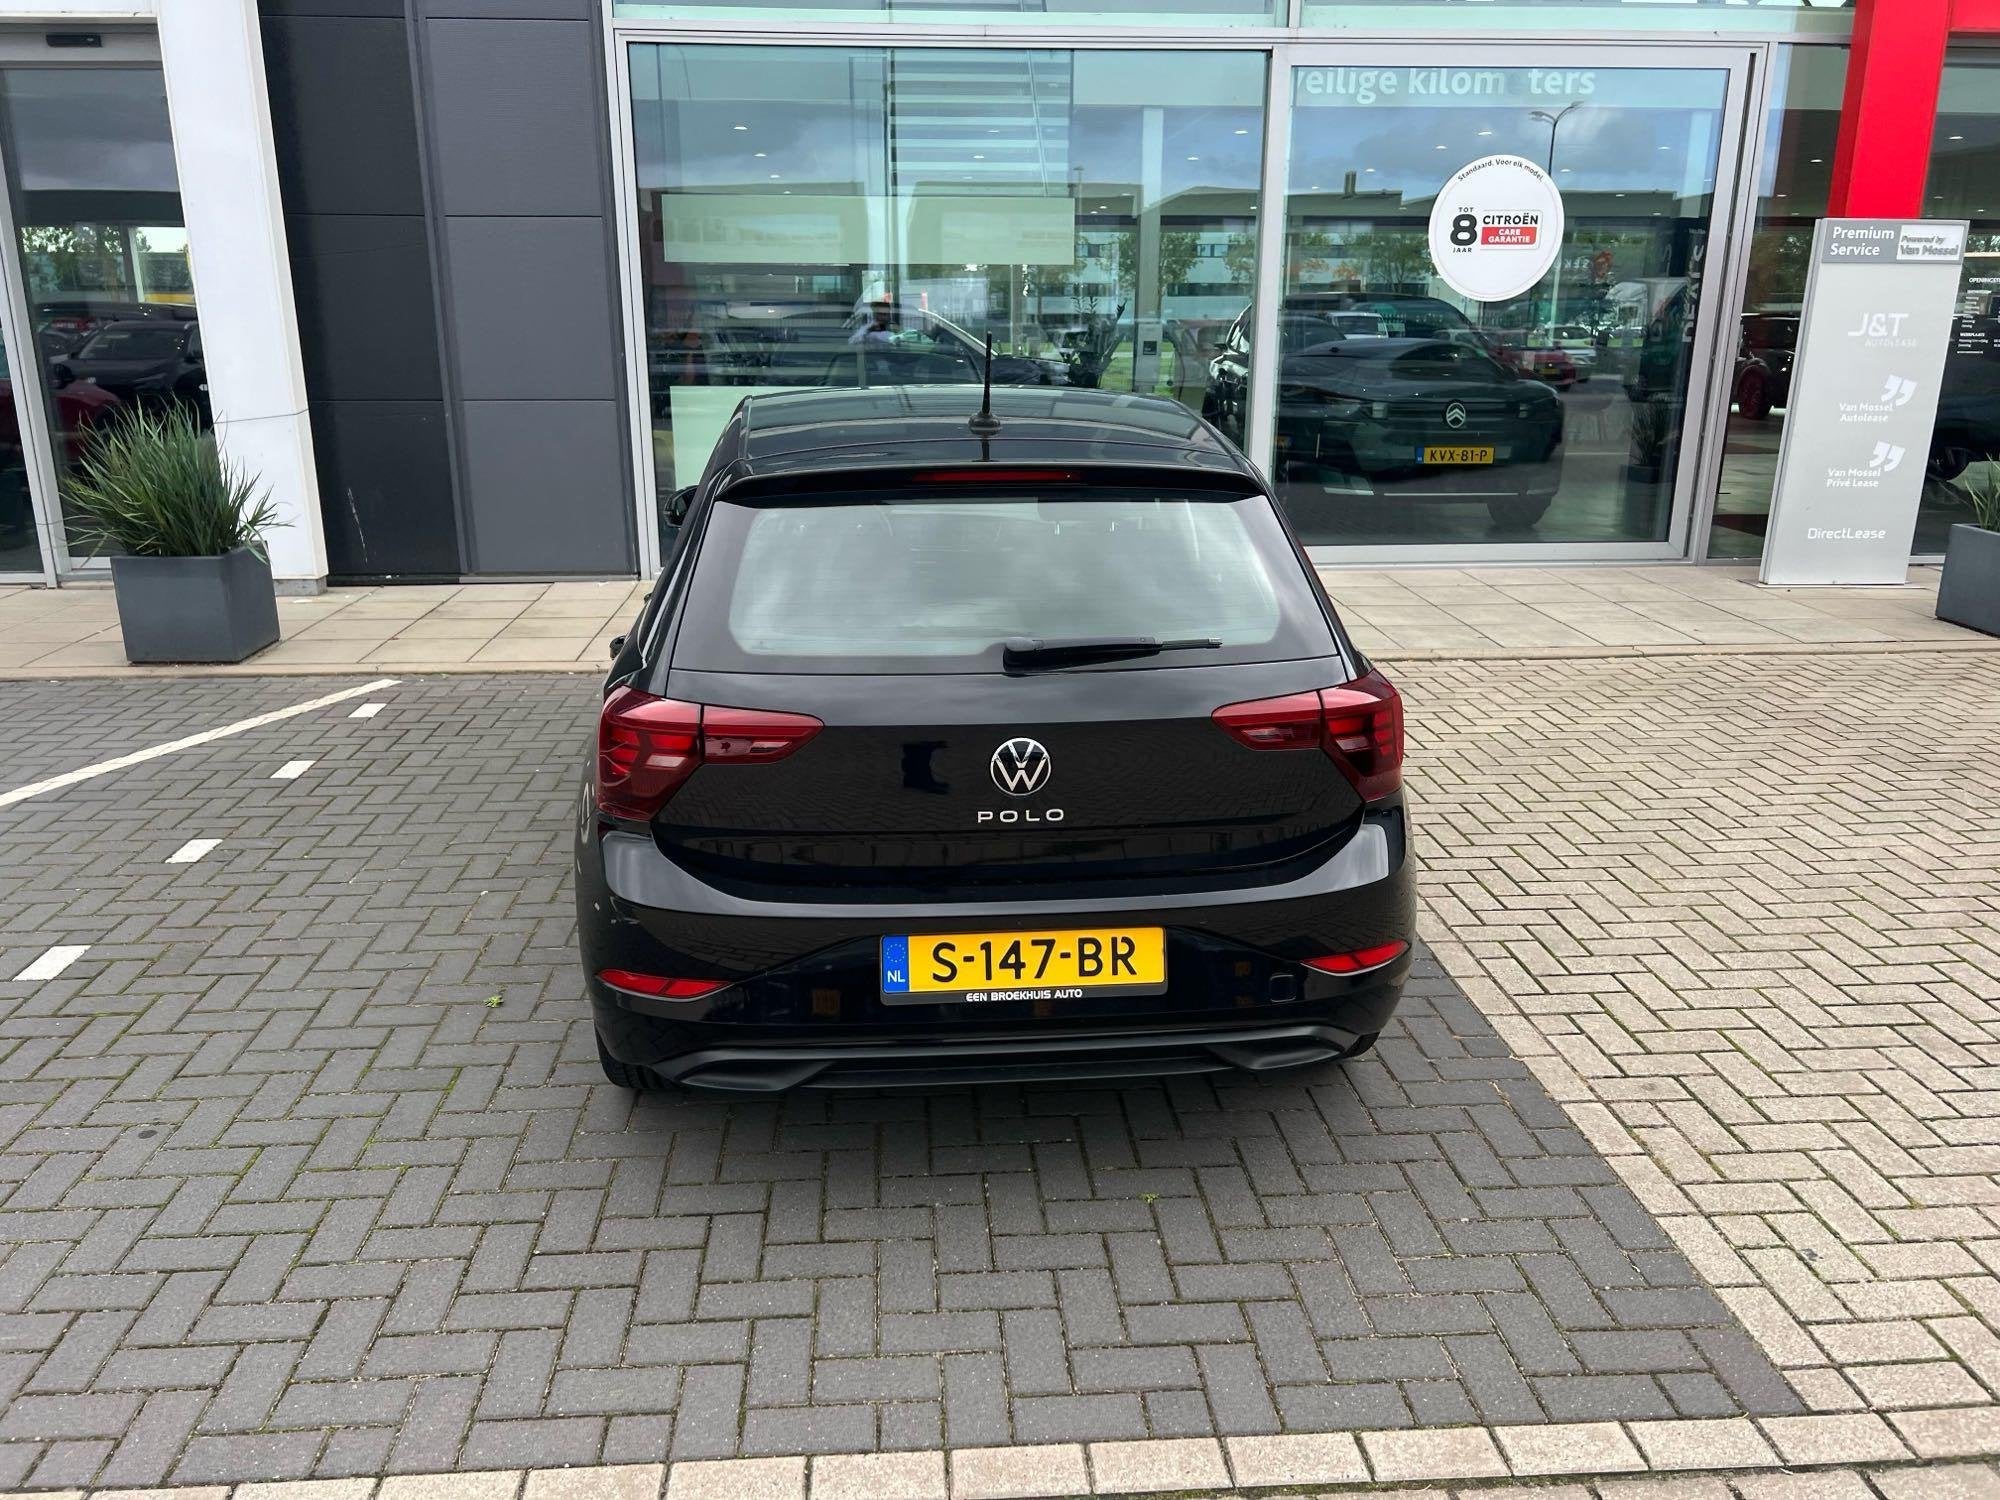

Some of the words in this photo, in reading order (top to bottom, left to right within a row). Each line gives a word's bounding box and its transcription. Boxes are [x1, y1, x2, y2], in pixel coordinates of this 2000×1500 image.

[1482, 212, 1539, 225] CITROËN
[1450, 214, 1477, 246] 8
[1499, 228, 1521, 236] CARE
[1832, 226, 1895, 239] Premium
[1488, 235, 1531, 244] GARANTIE
[1830, 242, 1881, 256] Service
[1900, 245, 1920, 255] Van
[1921, 245, 1959, 255] Mossel
[1847, 312, 1909, 337] J&T
[1839, 403, 1857, 412] Van
[1859, 403, 1894, 412] Mossel
[1839, 413, 1889, 422] Autolease
[1430, 449, 1488, 462] KVX-81-P
[1827, 468, 1846, 477] Van
[1847, 467, 1881, 477] Mossel
[1852, 478, 1880, 487] Lease
[1807, 527, 1887, 539] DirectLease
[976, 808, 1065, 824] POLO
[931, 936, 1138, 984] S-147-BR
[887, 970, 906, 983] NL
[966, 991, 988, 1002] EEN
[990, 989, 1051, 1000] BROEKHUIS
[1053, 988, 1083, 999] AUTO
